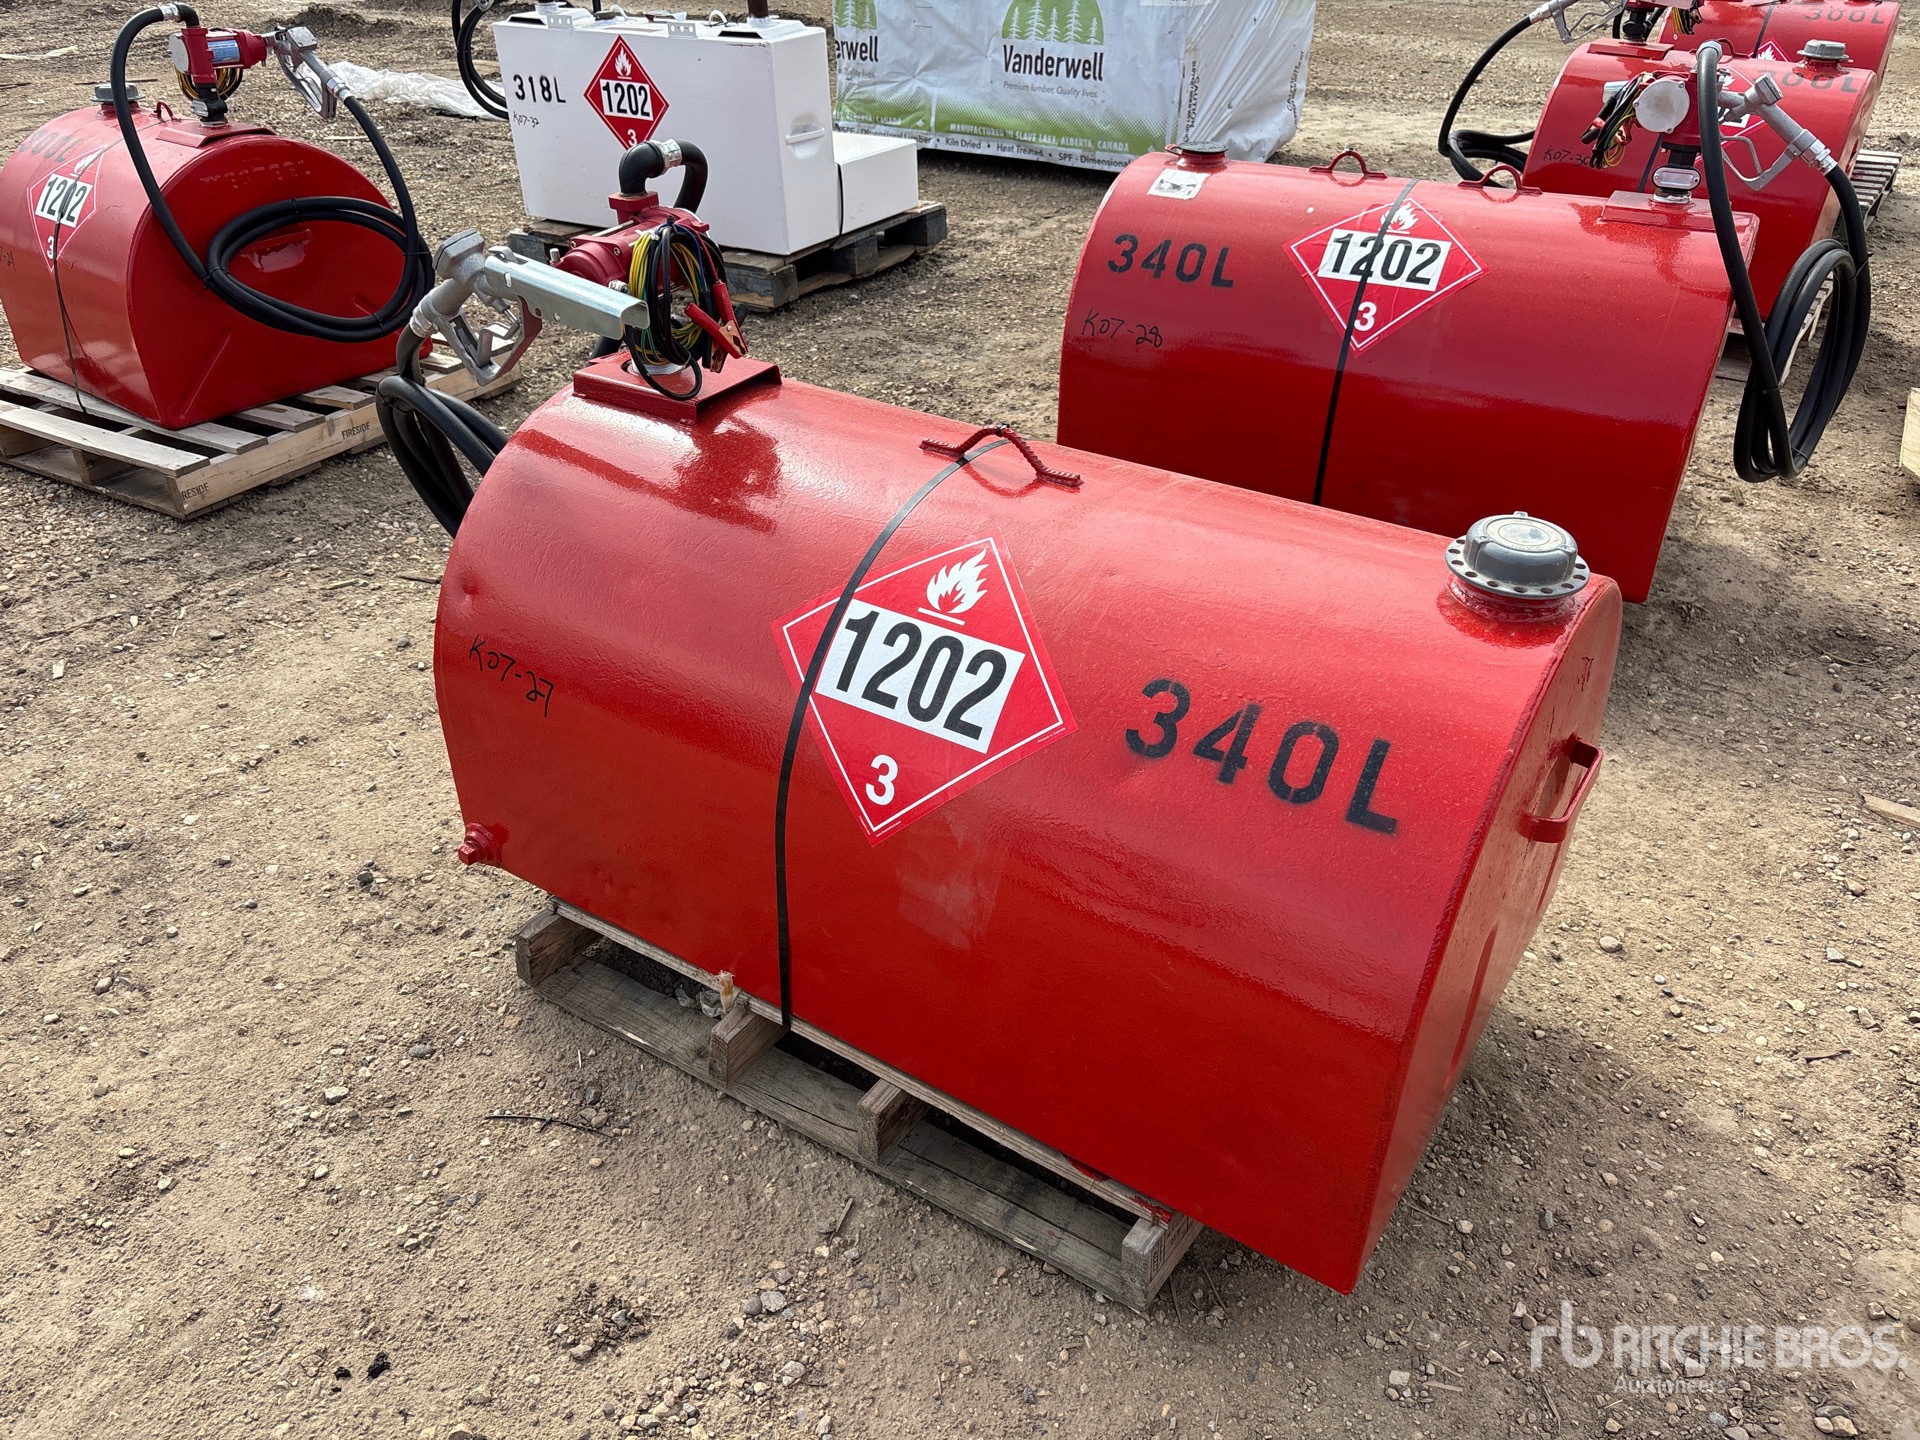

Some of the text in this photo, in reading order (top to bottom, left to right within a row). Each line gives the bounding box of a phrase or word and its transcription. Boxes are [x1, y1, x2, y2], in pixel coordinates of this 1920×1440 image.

[1804, 8, 1884, 24] 300L
[1003, 44, 1104, 82] Vanderwell
[513, 74, 567, 104] 318L
[602, 81, 651, 117] 1202
[1003, 81, 1030, 92] Premium
[1030, 83, 1055, 95] lumber,
[1056, 87, 1081, 98] Quality
[627, 128, 638, 146] 3
[945, 137, 960, 148] Kiln
[960, 139, 982, 150] Dried
[996, 142, 1015, 154] Heat
[1058, 152, 1073, 161] SPF
[1015, 131, 1037, 142] SLAVE
[1097, 140, 1130, 152] CANADA
[1107, 233, 1235, 288] 340L
[1331, 232, 1442, 286] 1202
[1081, 308, 1164, 348] K07-28
[1353, 301, 1378, 332] 3
[342, 421, 372, 440] FIRESIDE
[181, 482, 211, 501] RESIDE
[468, 633, 555, 719] K07-27
[836, 610, 1008, 741] 1202
[1125, 678, 1398, 836] 340L
[865, 754, 899, 806] 3
